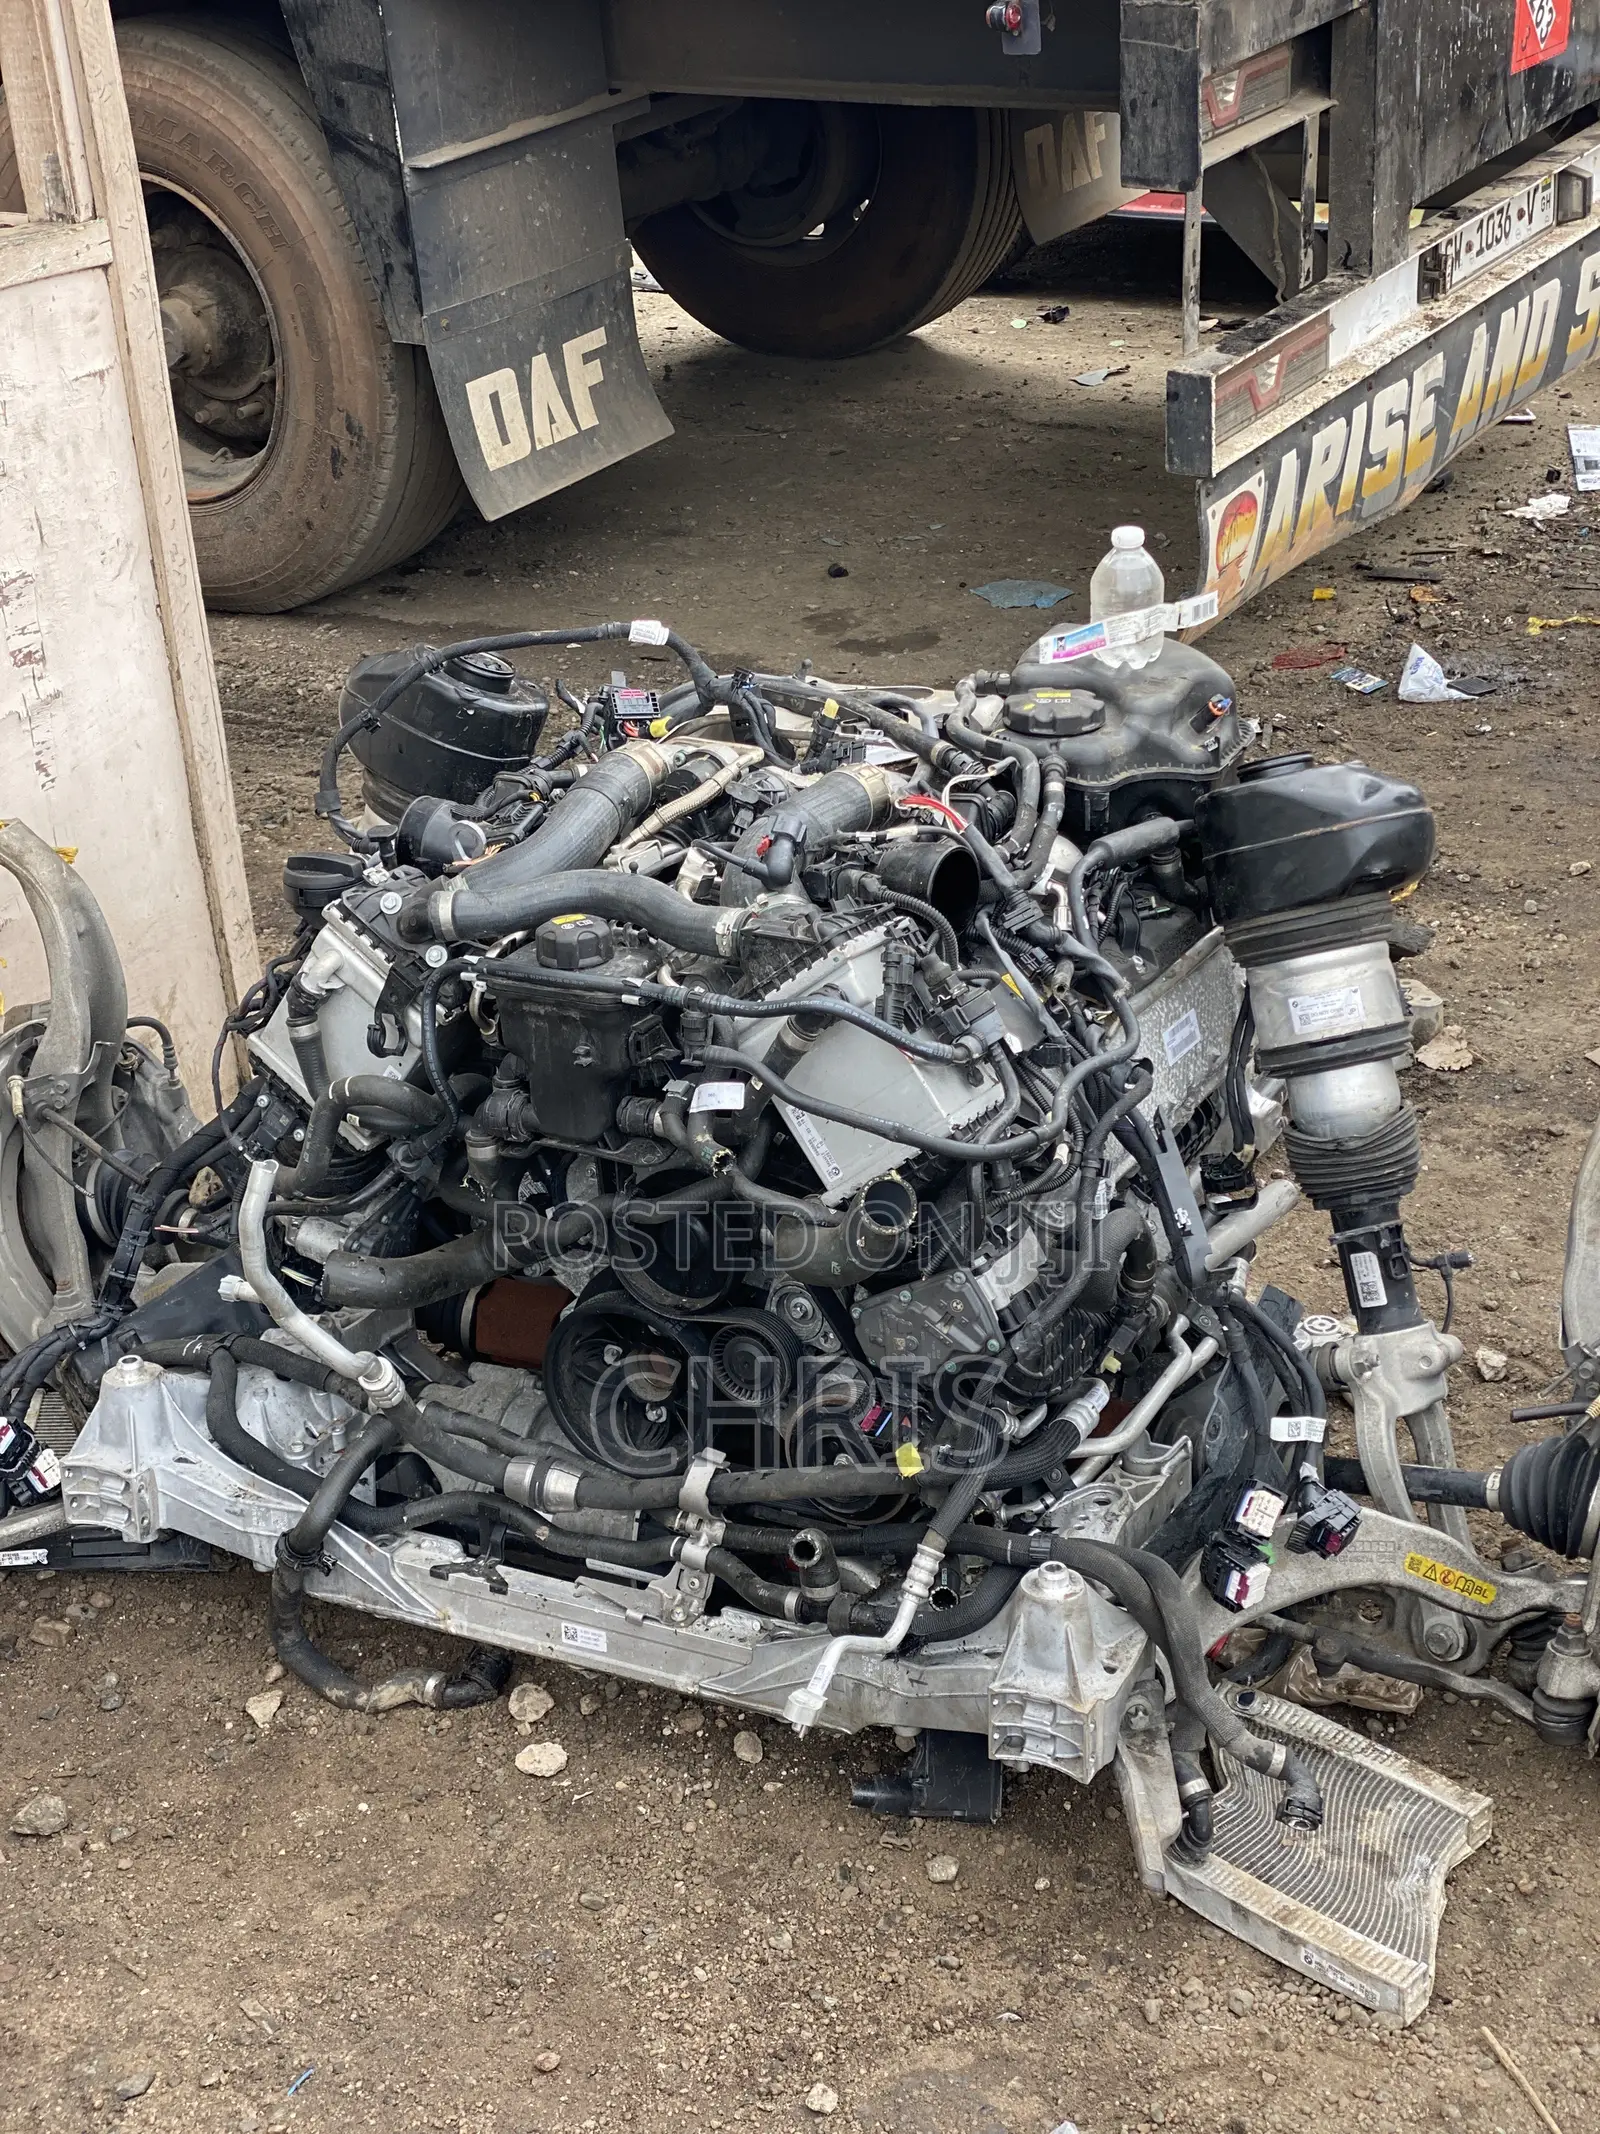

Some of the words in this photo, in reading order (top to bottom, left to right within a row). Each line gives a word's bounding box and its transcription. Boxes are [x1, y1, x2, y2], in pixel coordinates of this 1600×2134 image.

[130, 104, 291, 253] MARCH
[1023, 110, 1106, 200] DAF
[1475, 201, 1512, 258] 1036
[1527, 184, 1540, 226] V
[1540, 192, 1552, 213] GH
[465, 326, 608, 472] DAF
[1252, 351, 1446, 577] ARISE
[1450, 277, 1562, 440] AND
[1566, 250, 1600, 356] S
[1473, 1585, 1489, 1599] BL
